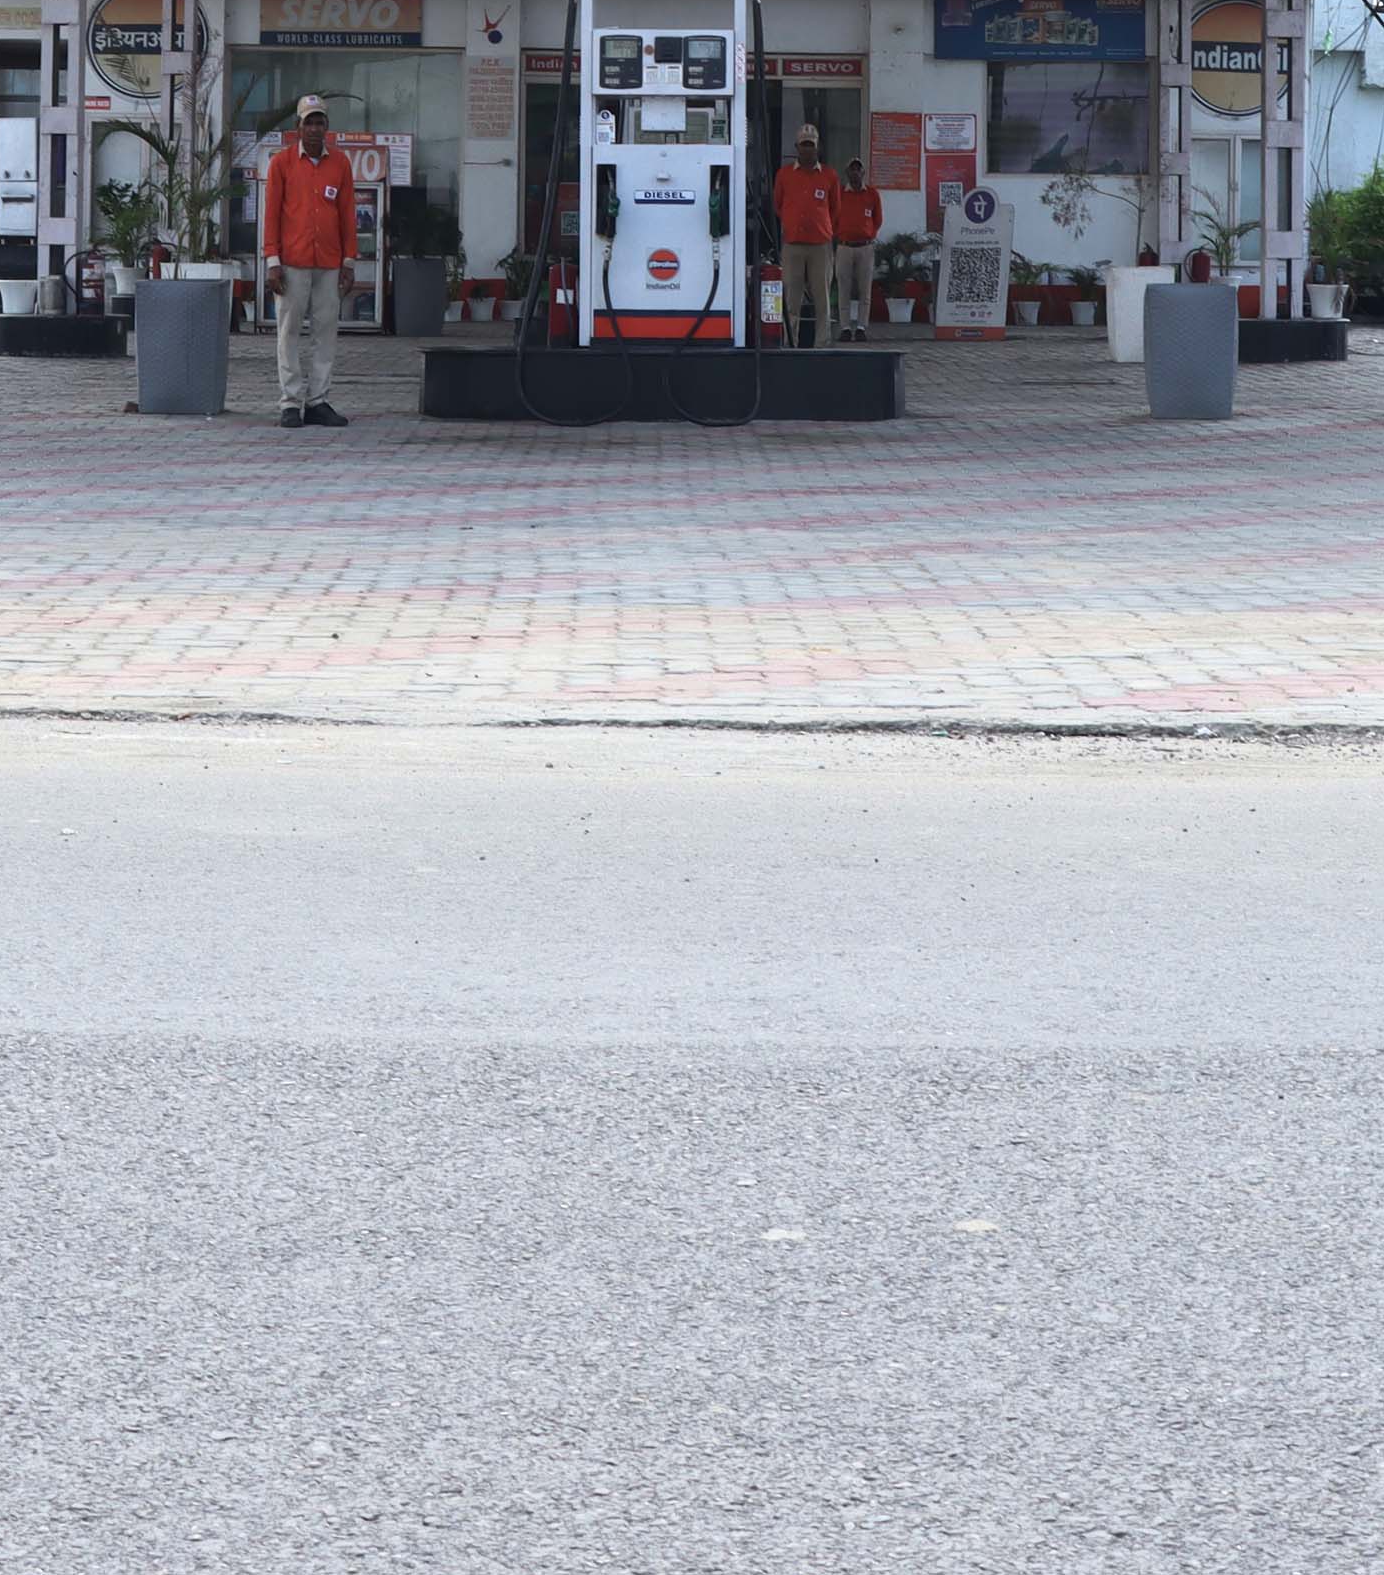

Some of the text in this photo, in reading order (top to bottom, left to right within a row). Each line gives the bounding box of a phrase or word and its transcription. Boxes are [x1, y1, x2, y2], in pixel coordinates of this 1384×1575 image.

[276, 33, 403, 45] WORLD-CLASS LUBRICANTS
[1193, 44, 1288, 72] ndianil
[790, 62, 855, 73] SERVO
[643, 191, 687, 199] DIESEL
[960, 226, 996, 236] PhonePe
[645, 282, 681, 290] IndianOil
